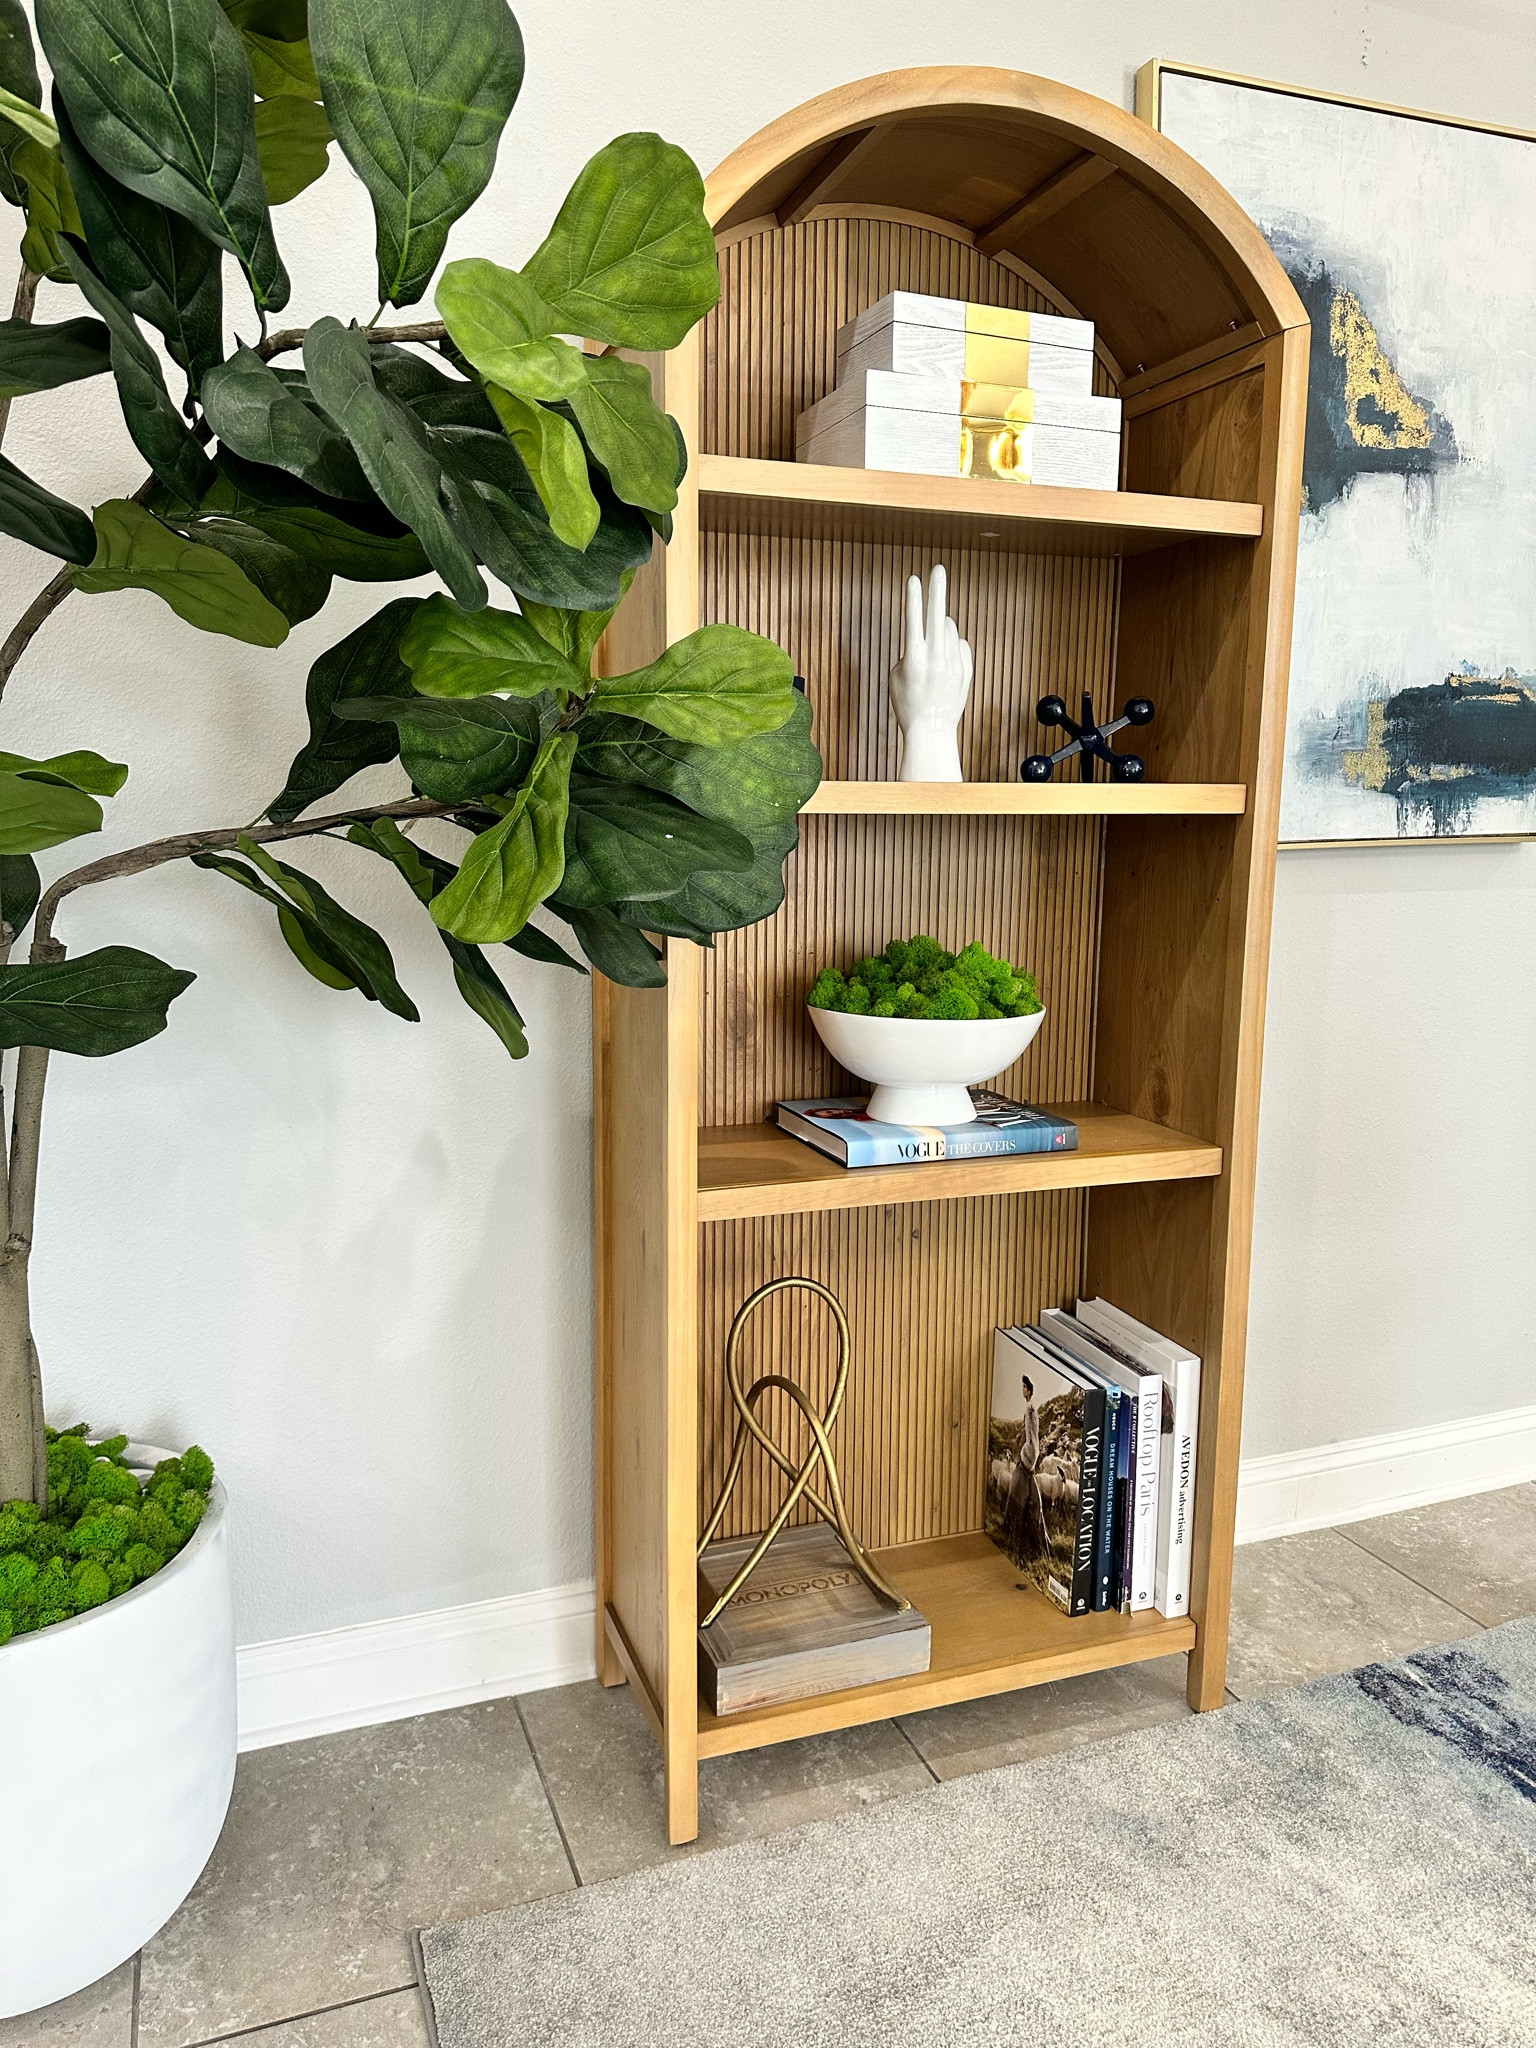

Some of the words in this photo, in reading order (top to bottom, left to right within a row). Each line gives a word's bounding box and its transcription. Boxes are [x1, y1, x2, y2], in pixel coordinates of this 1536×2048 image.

[896, 1140, 945, 1158] VOGUE
[947, 1143, 972, 1156] THE
[973, 1139, 1017, 1154] COVERS
[1083, 1427, 1100, 1480] VOGUE
[1139, 1392, 1159, 1467] Rooftop
[1107, 1470, 1115, 1499] HOUSES
[1180, 1435, 1190, 1488] AVEDON
[1106, 1500, 1113, 1512] ON
[1140, 1472, 1157, 1517] Paris
[1176, 1491, 1187, 1545] advertising
[1077, 1488, 1096, 1571] LOCATION
[728, 1572, 851, 1607] MONOPOLY
